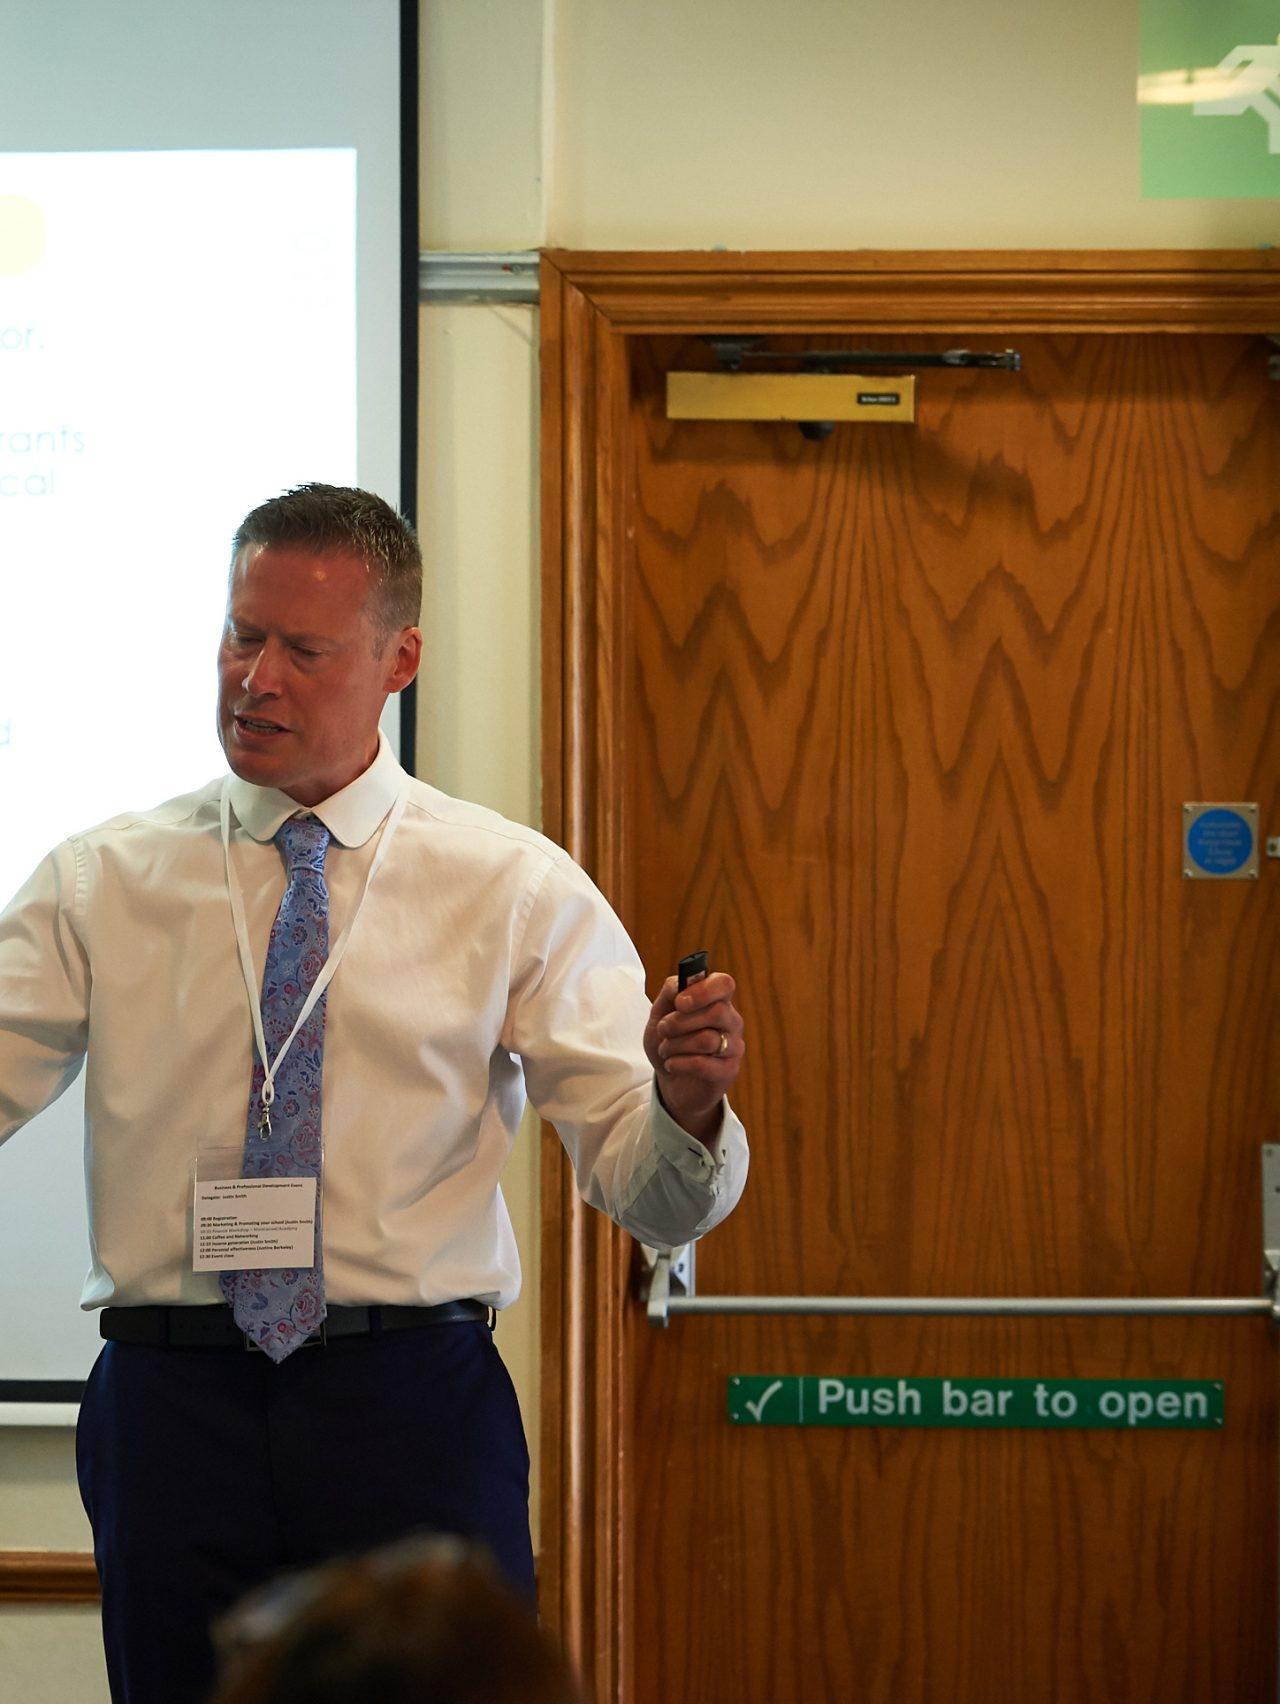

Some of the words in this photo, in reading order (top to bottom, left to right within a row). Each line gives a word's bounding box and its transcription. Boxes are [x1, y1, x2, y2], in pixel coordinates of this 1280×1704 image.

[818, 1379, 921, 1416] Push
[942, 1380, 1013, 1417] bar
[1033, 1383, 1078, 1418] to
[1098, 1387, 1209, 1427] open
